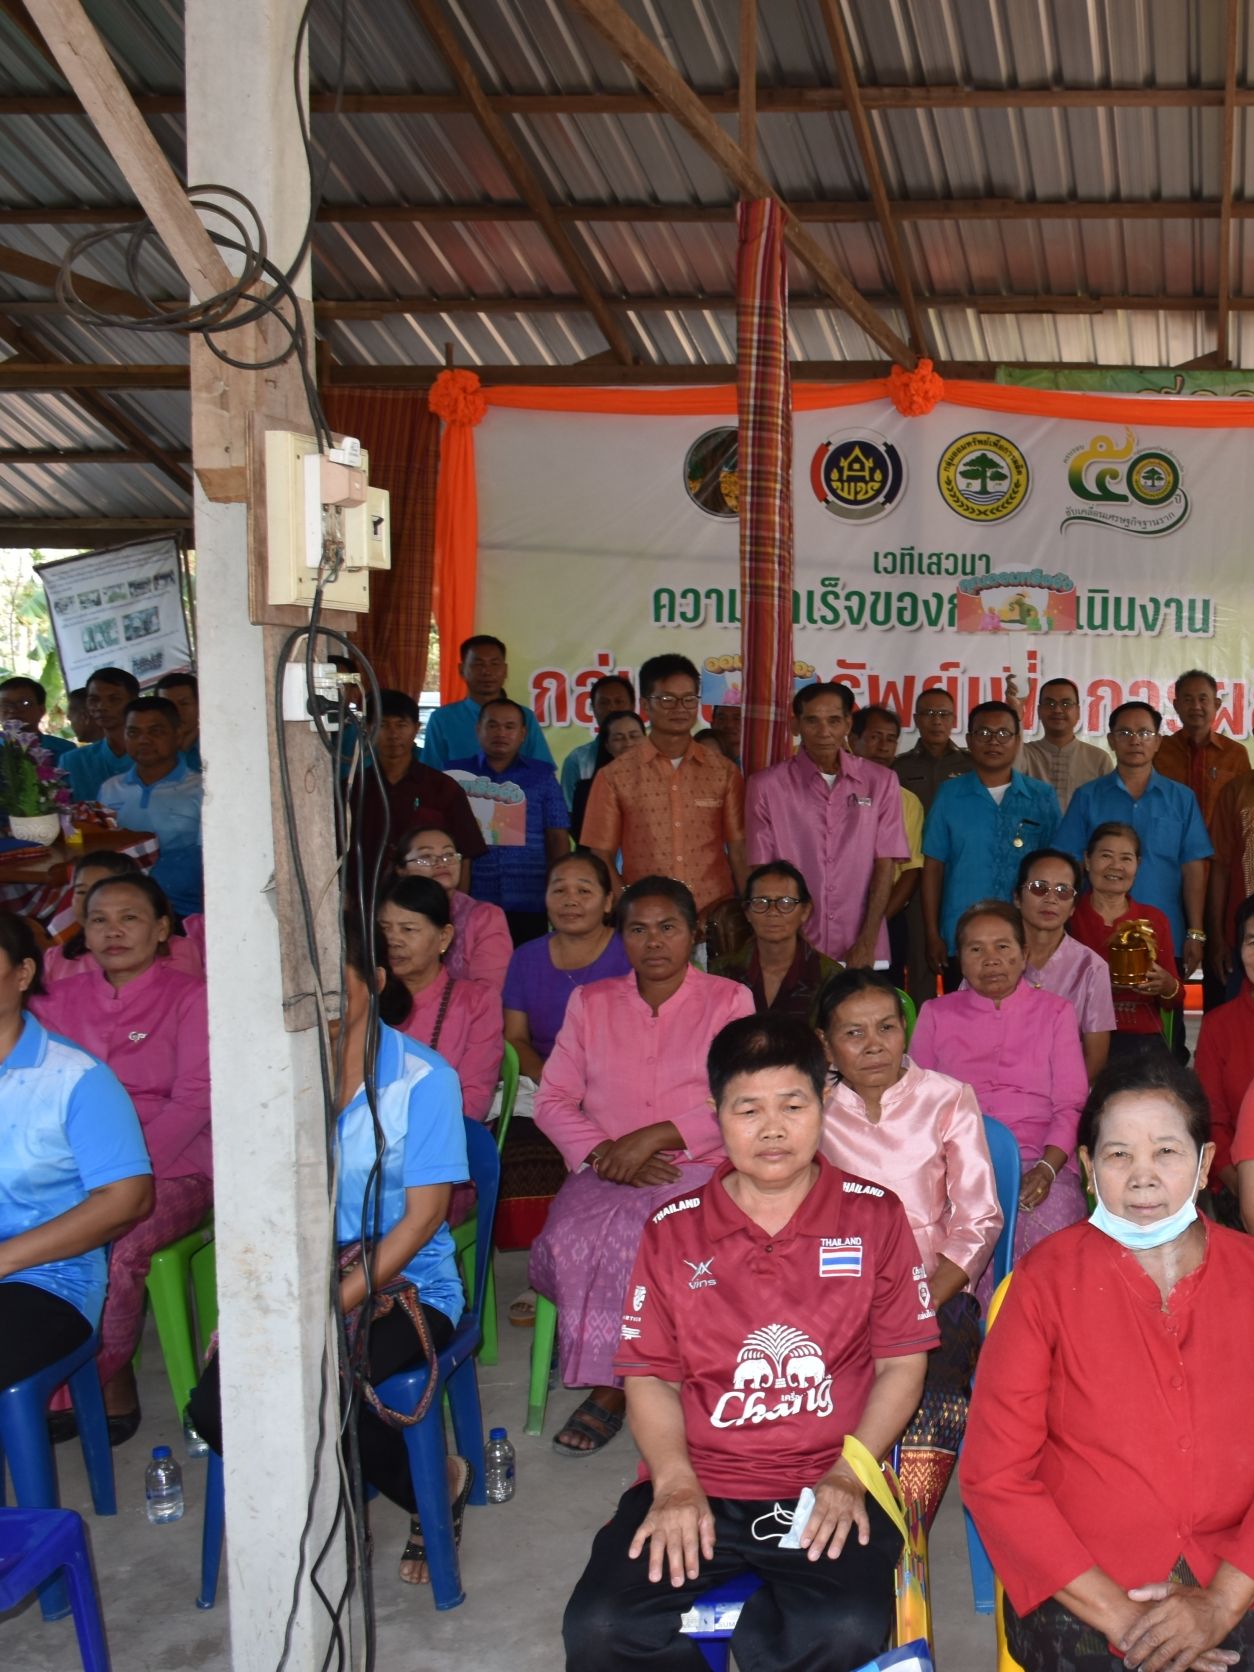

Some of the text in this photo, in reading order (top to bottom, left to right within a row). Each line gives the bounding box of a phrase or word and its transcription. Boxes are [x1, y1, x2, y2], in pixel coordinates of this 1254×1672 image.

[873, 545, 991, 577] เวทีเสวนา
[652, 1198, 701, 1224] THAILAND
[820, 1237, 862, 1248] THAILAND
[710, 1379, 834, 1428] Chang
